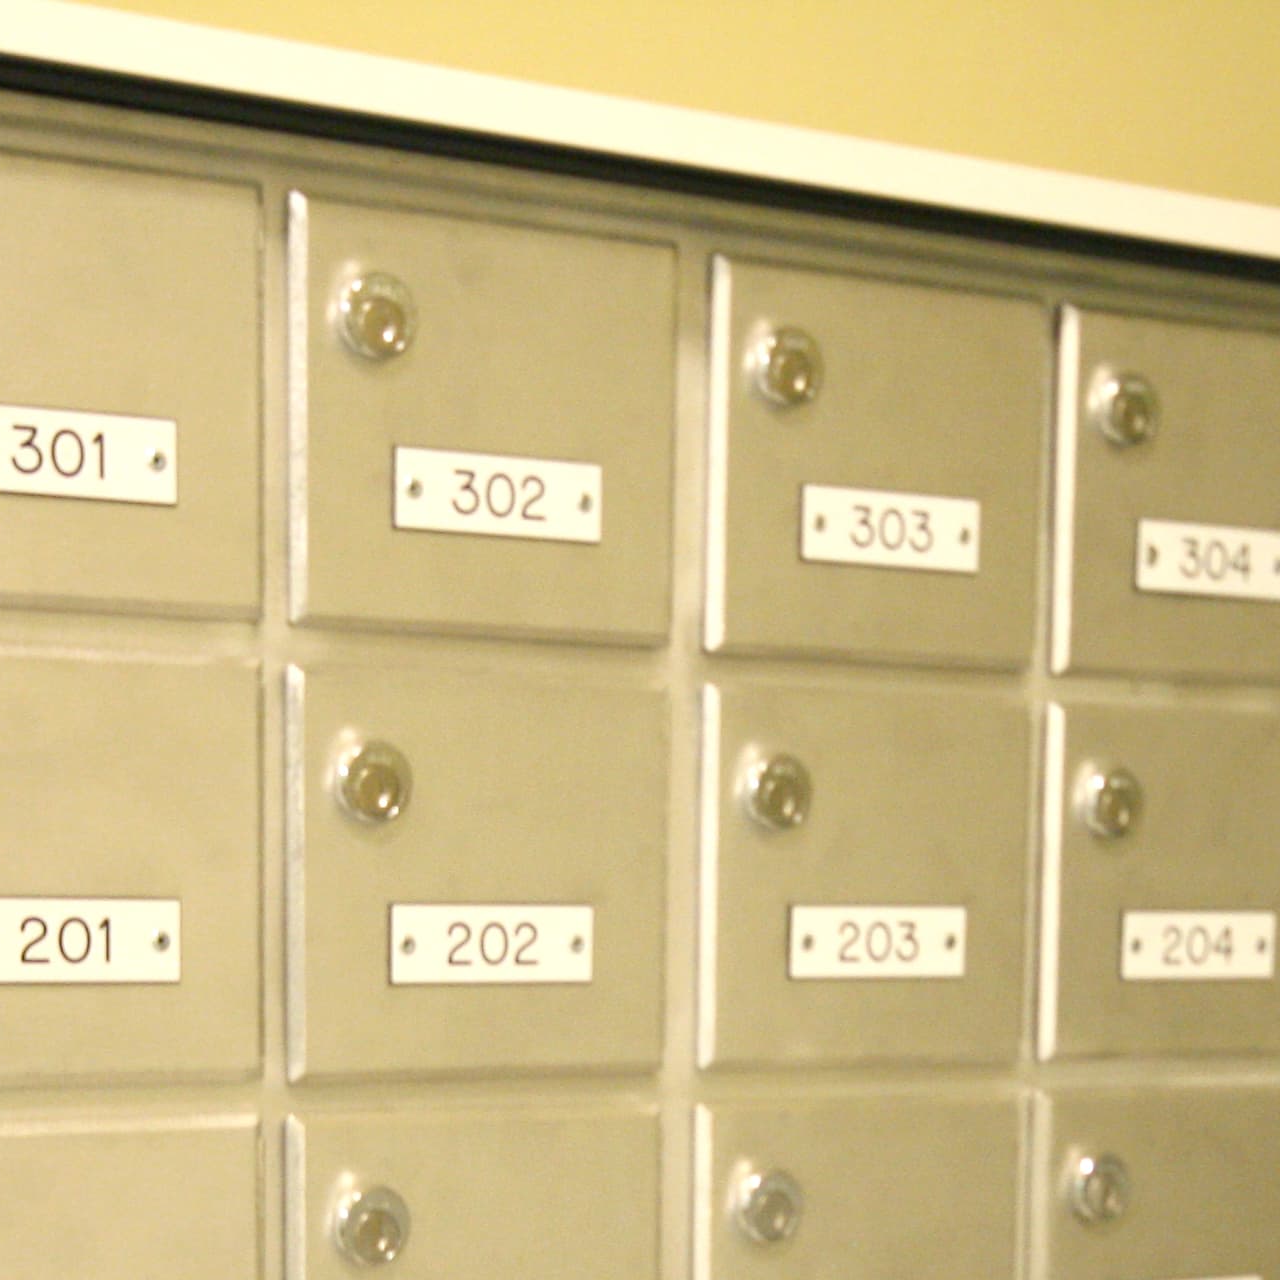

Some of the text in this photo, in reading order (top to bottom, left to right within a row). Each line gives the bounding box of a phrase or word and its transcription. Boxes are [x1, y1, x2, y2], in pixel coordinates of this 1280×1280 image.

[10, 423, 107, 481] 301
[450, 467, 548, 523] 302
[848, 503, 936, 555] 303
[1178, 535, 1255, 583] 304
[18, 915, 113, 966] 201
[445, 919, 541, 968] 202
[836, 919, 922, 965] 203
[1160, 923, 1237, 968] 204
